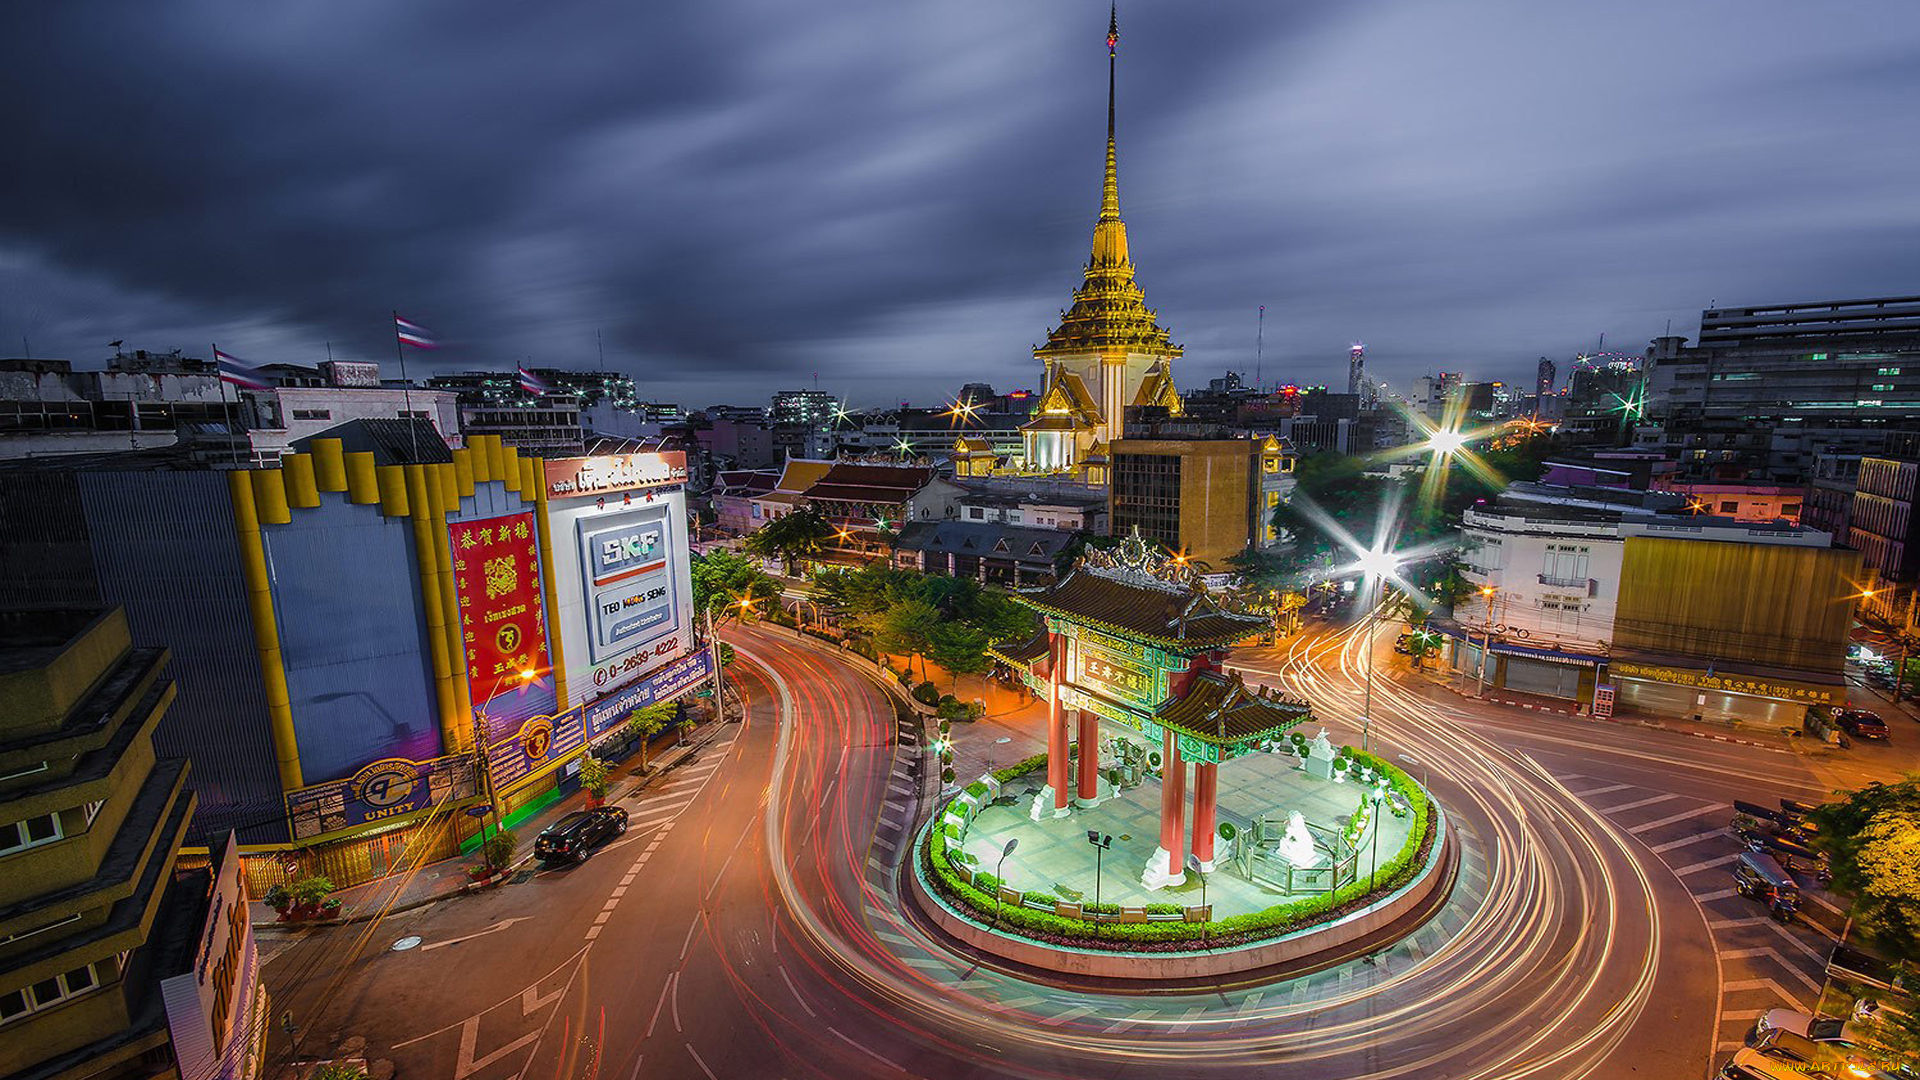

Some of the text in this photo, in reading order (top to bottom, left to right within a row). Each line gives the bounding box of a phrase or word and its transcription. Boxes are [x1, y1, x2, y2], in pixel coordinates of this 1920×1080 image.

[602, 530, 659, 565] SKF
[602, 601, 620, 615] TEO
[647, 586, 667, 601] SENG
[609, 637, 679, 678] 0-2639-4222
[364, 801, 415, 821] UNITY
